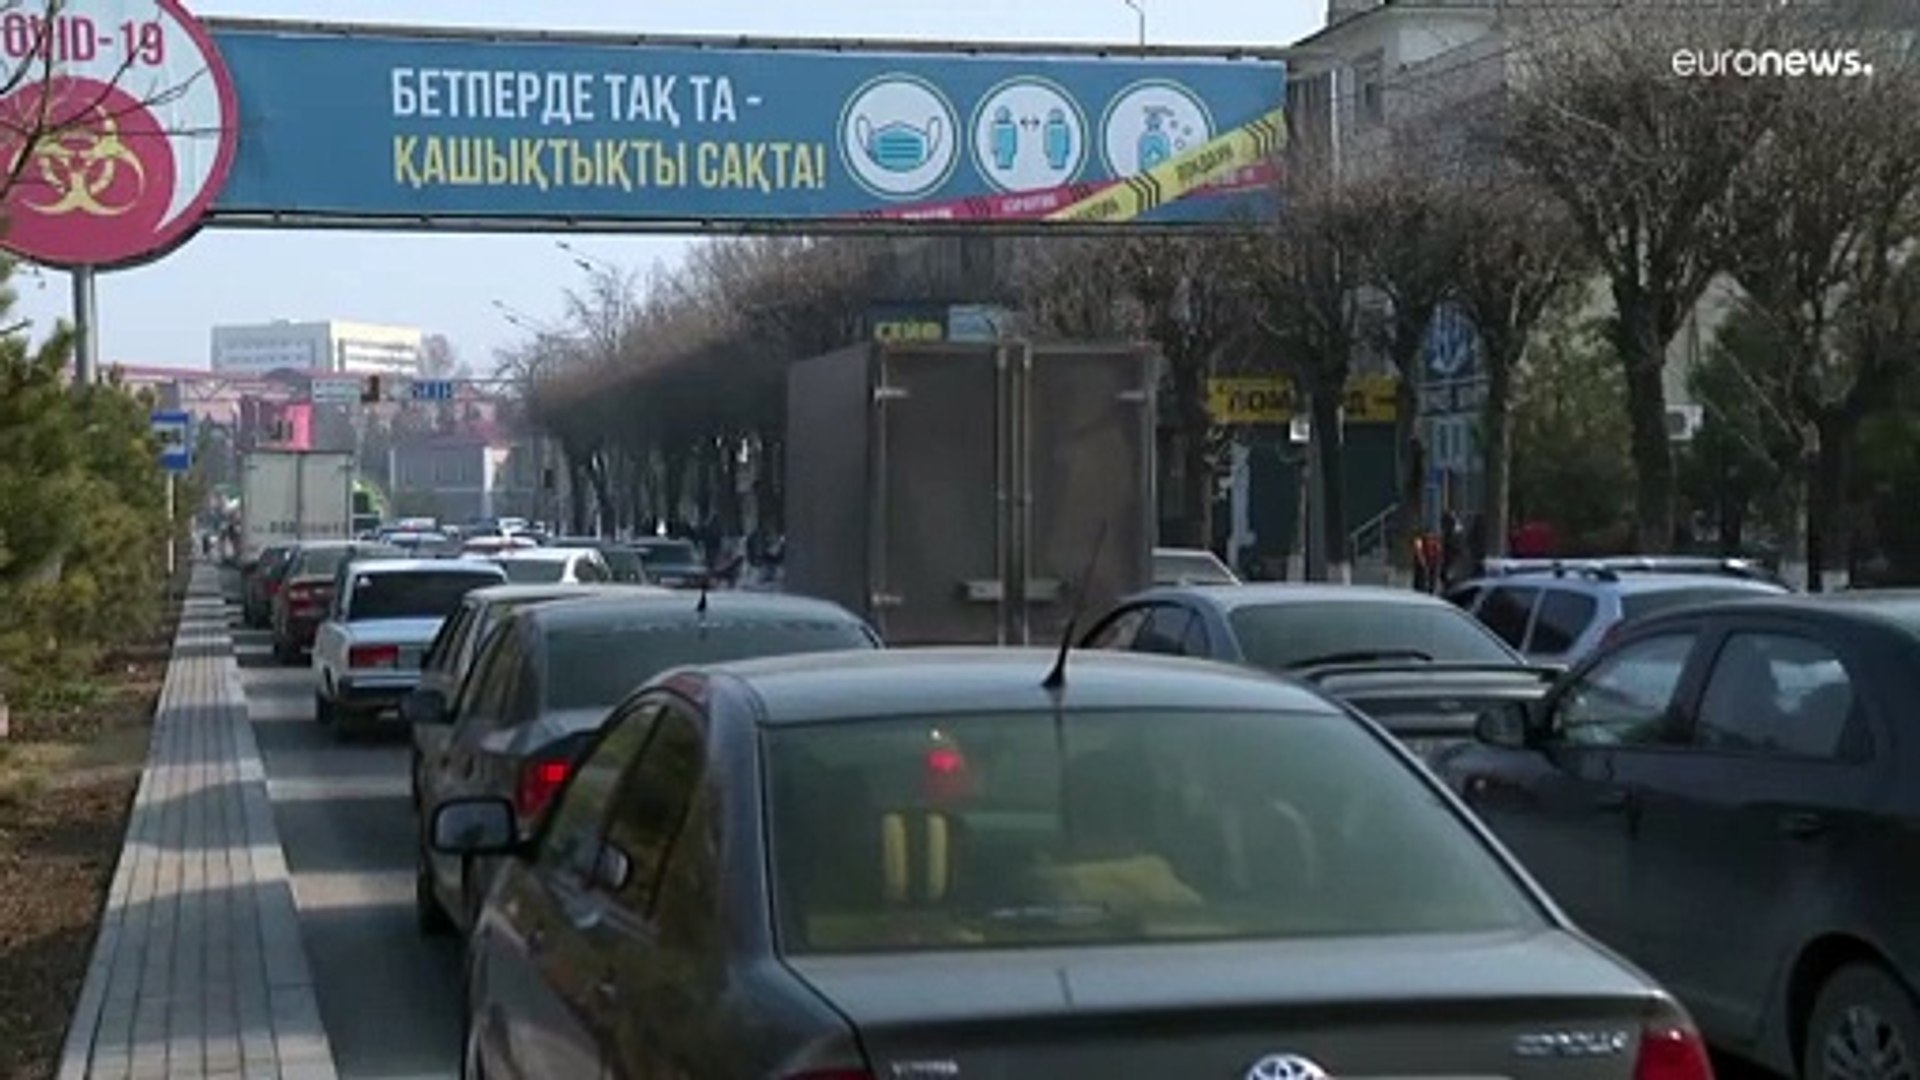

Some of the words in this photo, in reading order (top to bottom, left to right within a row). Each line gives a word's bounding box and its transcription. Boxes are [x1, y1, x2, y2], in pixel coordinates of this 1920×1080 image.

[0, 14, 164, 66] OVID-19
[392, 67, 595, 126] БЕТПЕРДЕ
[604, 73, 681, 127] ТАҚ
[690, 75, 737, 122] ТА
[393, 135, 688, 192] ҚАШЫҚТЫҚТЫ
[698, 141, 826, 194] САҚТА!
